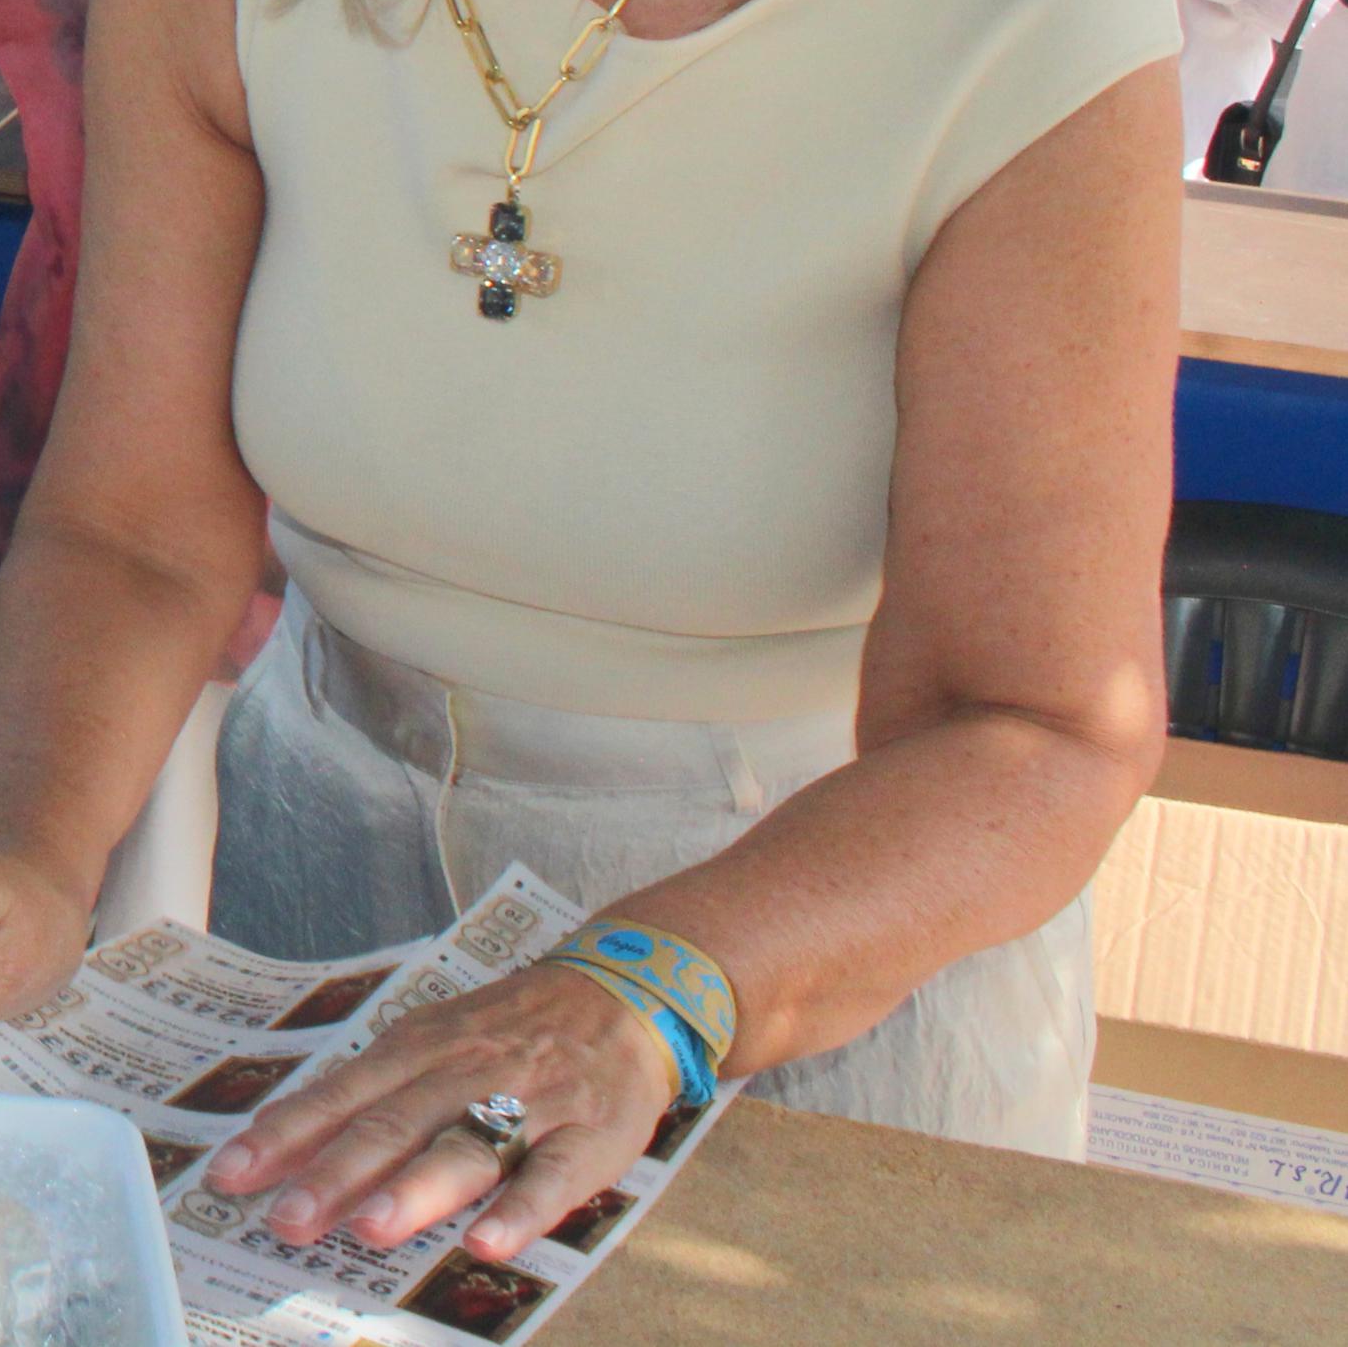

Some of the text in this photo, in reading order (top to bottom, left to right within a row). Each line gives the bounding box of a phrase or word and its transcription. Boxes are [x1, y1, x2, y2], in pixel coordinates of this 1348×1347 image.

[427, 981, 449, 1000] 20
[38, 1033, 173, 1098] 92453
[239, 1228, 400, 1295] 92453
